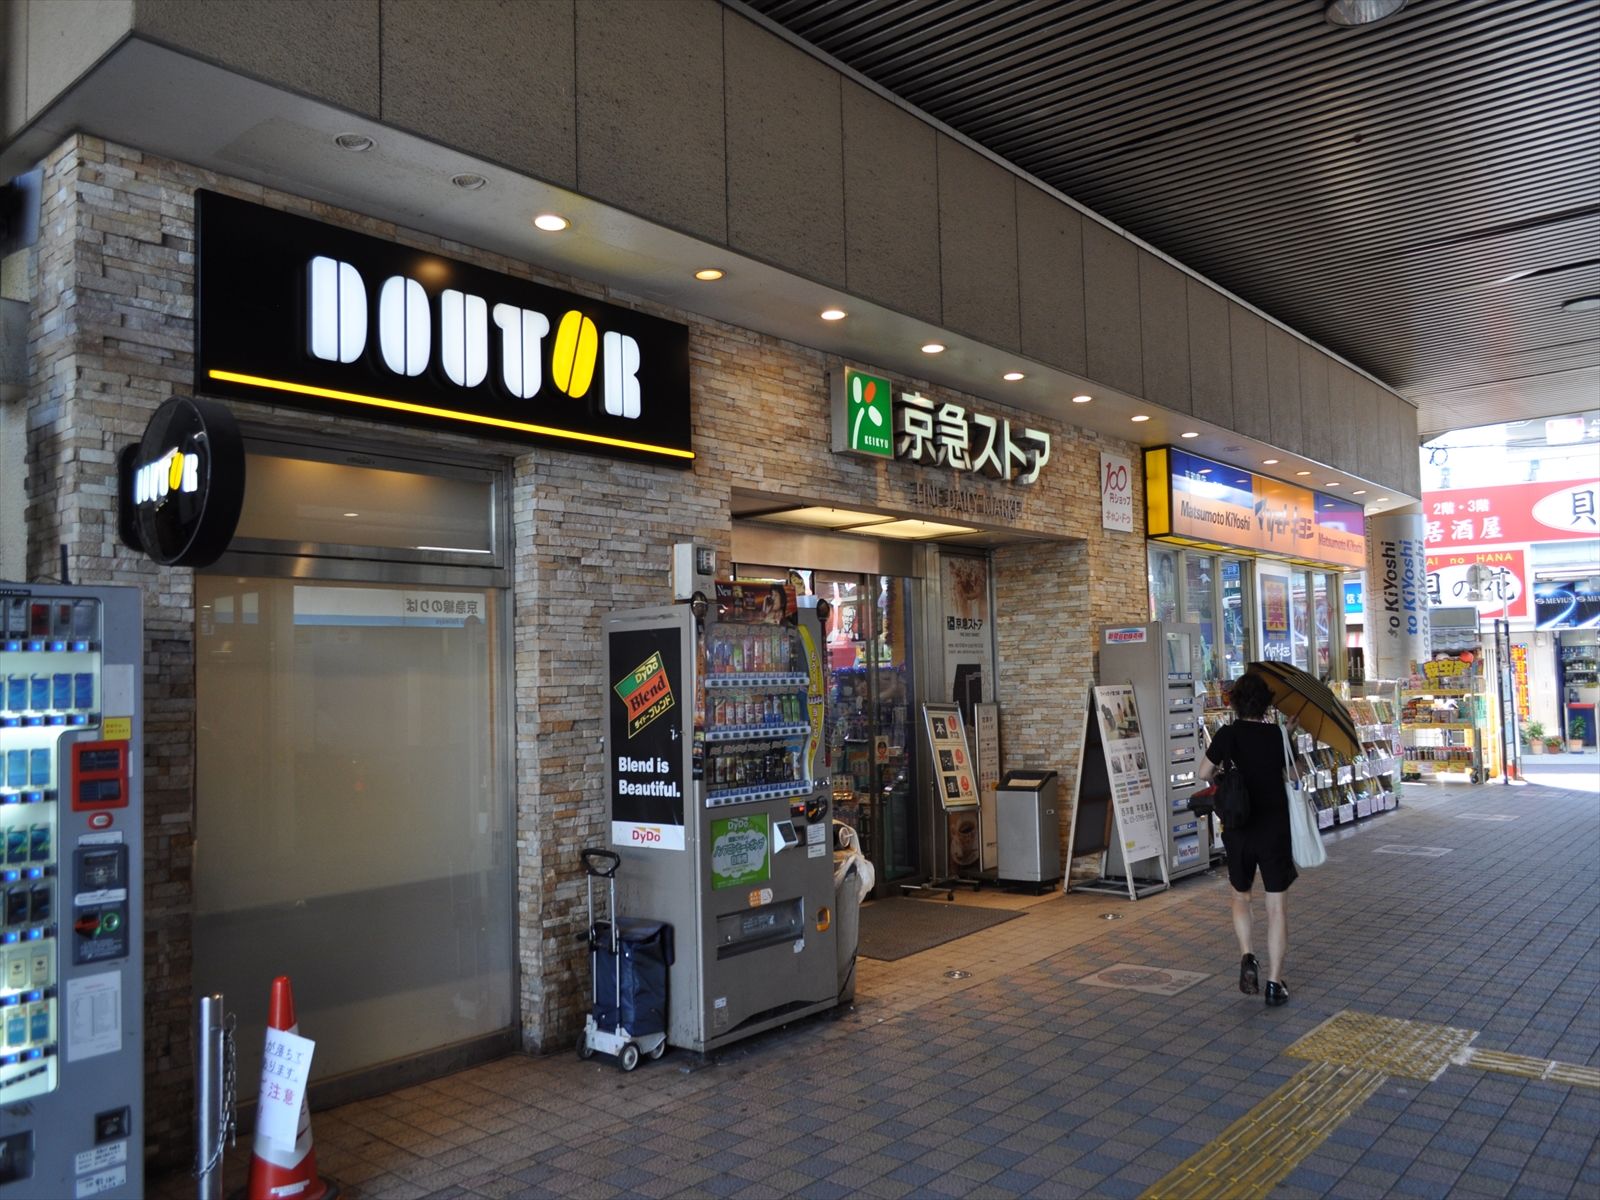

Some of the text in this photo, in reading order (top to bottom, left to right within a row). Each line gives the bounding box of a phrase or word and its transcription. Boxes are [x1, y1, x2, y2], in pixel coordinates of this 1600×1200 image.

[310, 255, 642, 419] DOUTOR
[864, 433, 889, 449] KEIKYU
[901, 391, 1050, 485] 京急ストア
[1103, 461, 1128, 495] 100
[1180, 499, 1251, 531] Matsumoto KiYoshi
[1424, 515, 1503, 543] 居酒屋
[1449, 556, 1464, 564] no
[1475, 552, 1512, 563] HANA
[1380, 540, 1399, 612] KiYoshi
[1398, 539, 1416, 611] KiYoshi
[1545, 595, 1573, 605] MEVIUS
[634, 659, 659, 683] DyDo
[629, 674, 666, 712] Blend
[618, 756, 670, 774] Blend is
[618, 779, 681, 798] Beautiful.
[632, 828, 661, 844] DyDo
[727, 819, 749, 831] DyDo
[260, 1079, 295, 1106] 注意
